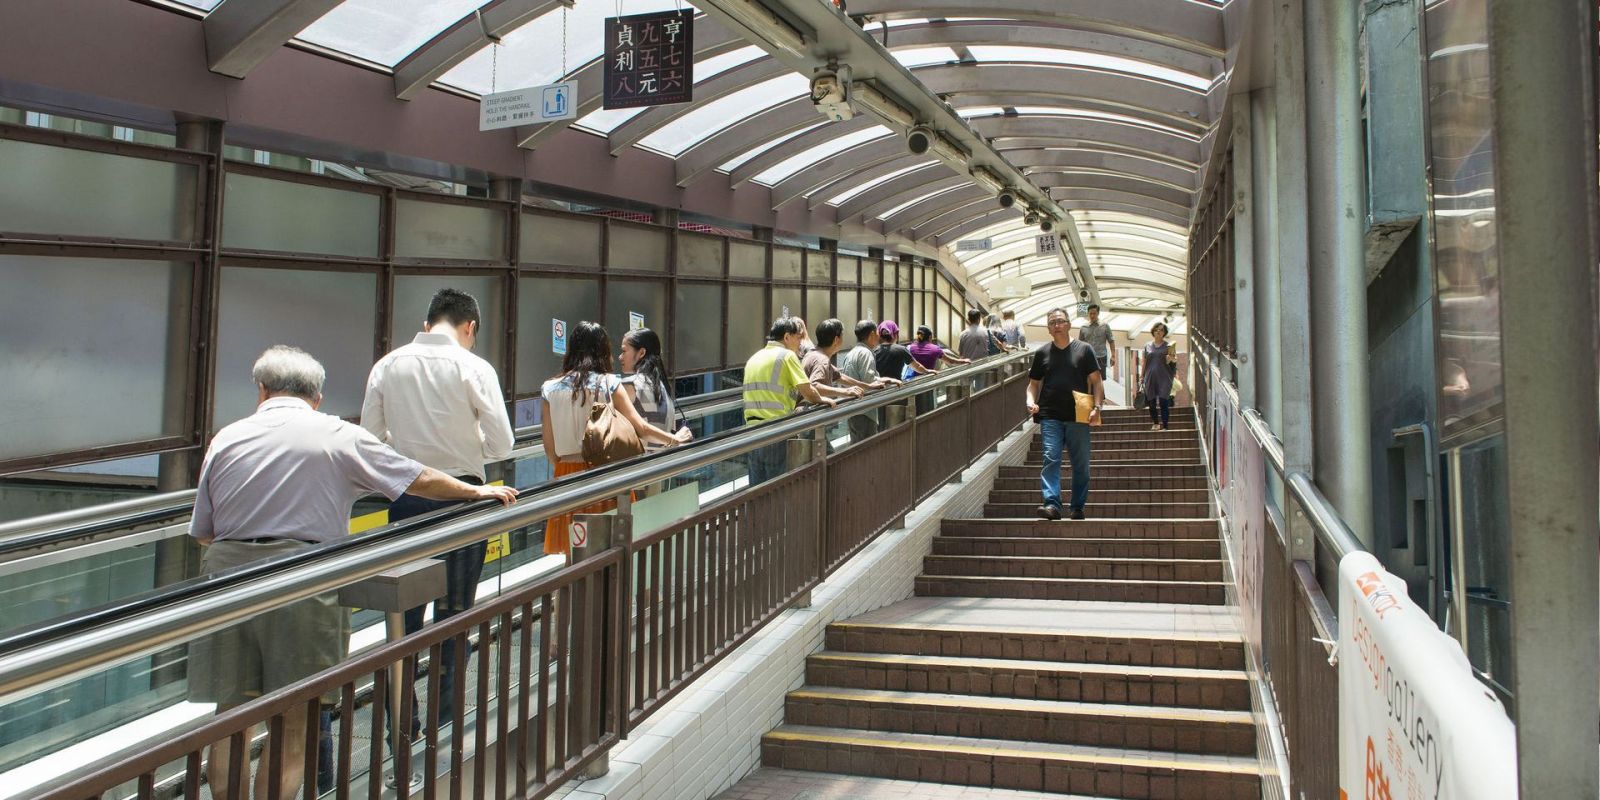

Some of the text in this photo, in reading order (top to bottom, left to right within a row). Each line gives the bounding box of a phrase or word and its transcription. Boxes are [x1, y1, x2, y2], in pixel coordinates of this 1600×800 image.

[486, 95, 523, 106] STEEP GRADIENT
[486, 102, 531, 115] HOLD THE HANDRAIL
